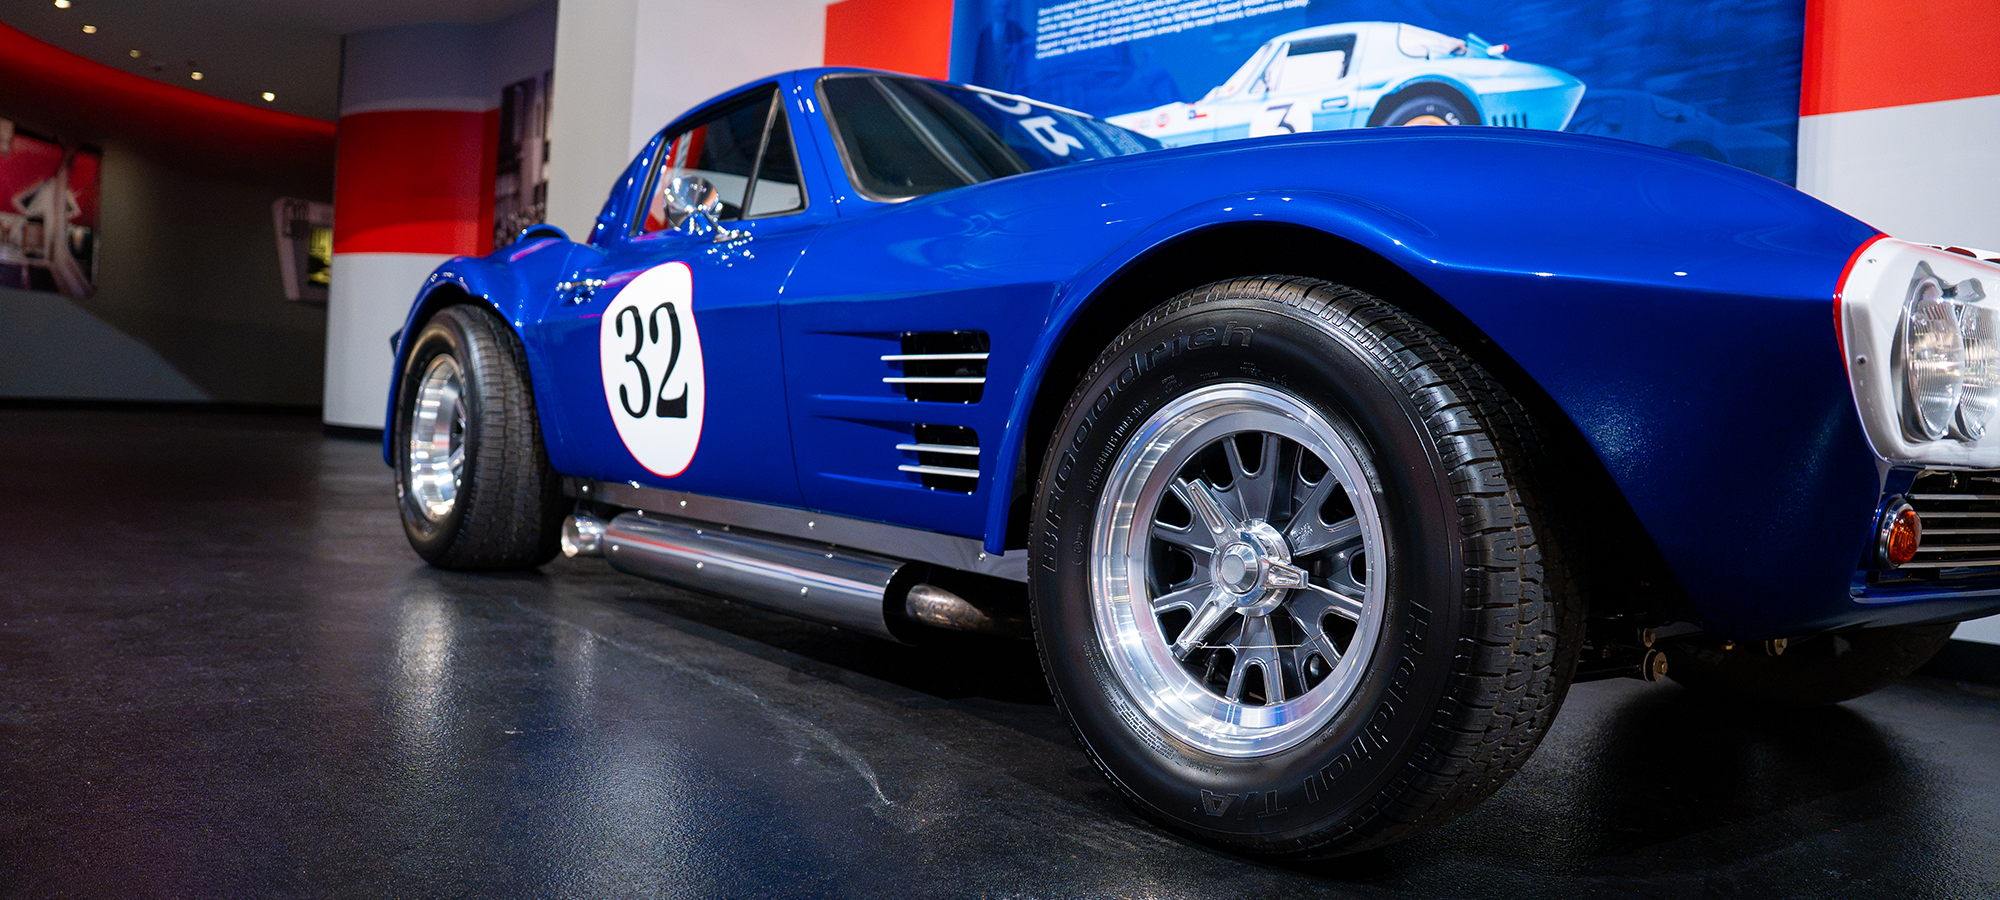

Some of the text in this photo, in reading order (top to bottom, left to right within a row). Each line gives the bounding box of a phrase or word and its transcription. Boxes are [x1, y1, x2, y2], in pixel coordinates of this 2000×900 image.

[1244, 2, 1282, 17] Corvettes
[1266, 103, 1296, 133] 3
[615, 301, 688, 419] 32
[1040, 319, 1255, 574] BFGoodrich
[1303, 599, 1434, 805] Radial
[1193, 788, 1291, 820] T/A
